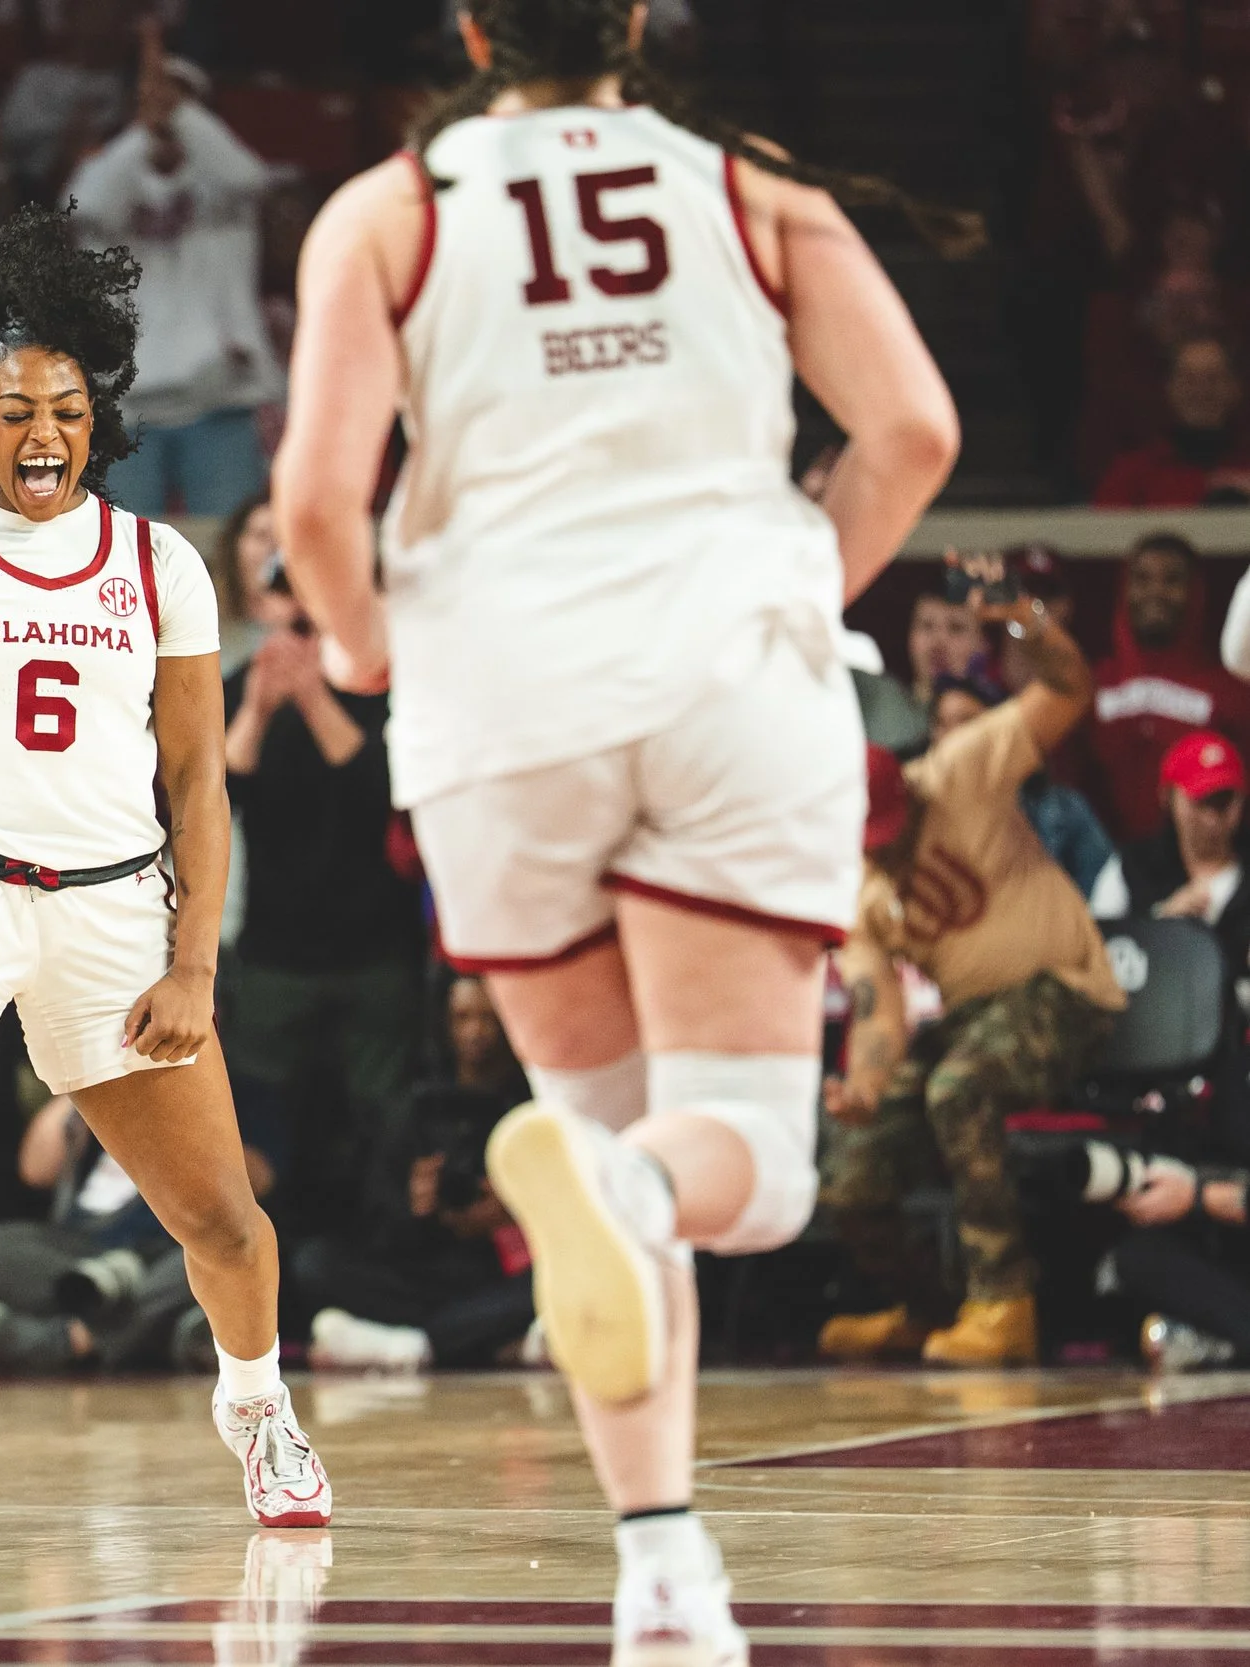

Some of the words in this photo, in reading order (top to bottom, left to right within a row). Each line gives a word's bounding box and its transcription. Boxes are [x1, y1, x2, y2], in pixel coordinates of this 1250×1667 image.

[507, 165, 670, 304] 15
[543, 320, 668, 376] BEERS
[100, 578, 137, 616] SEC
[16, 659, 80, 752] 6
